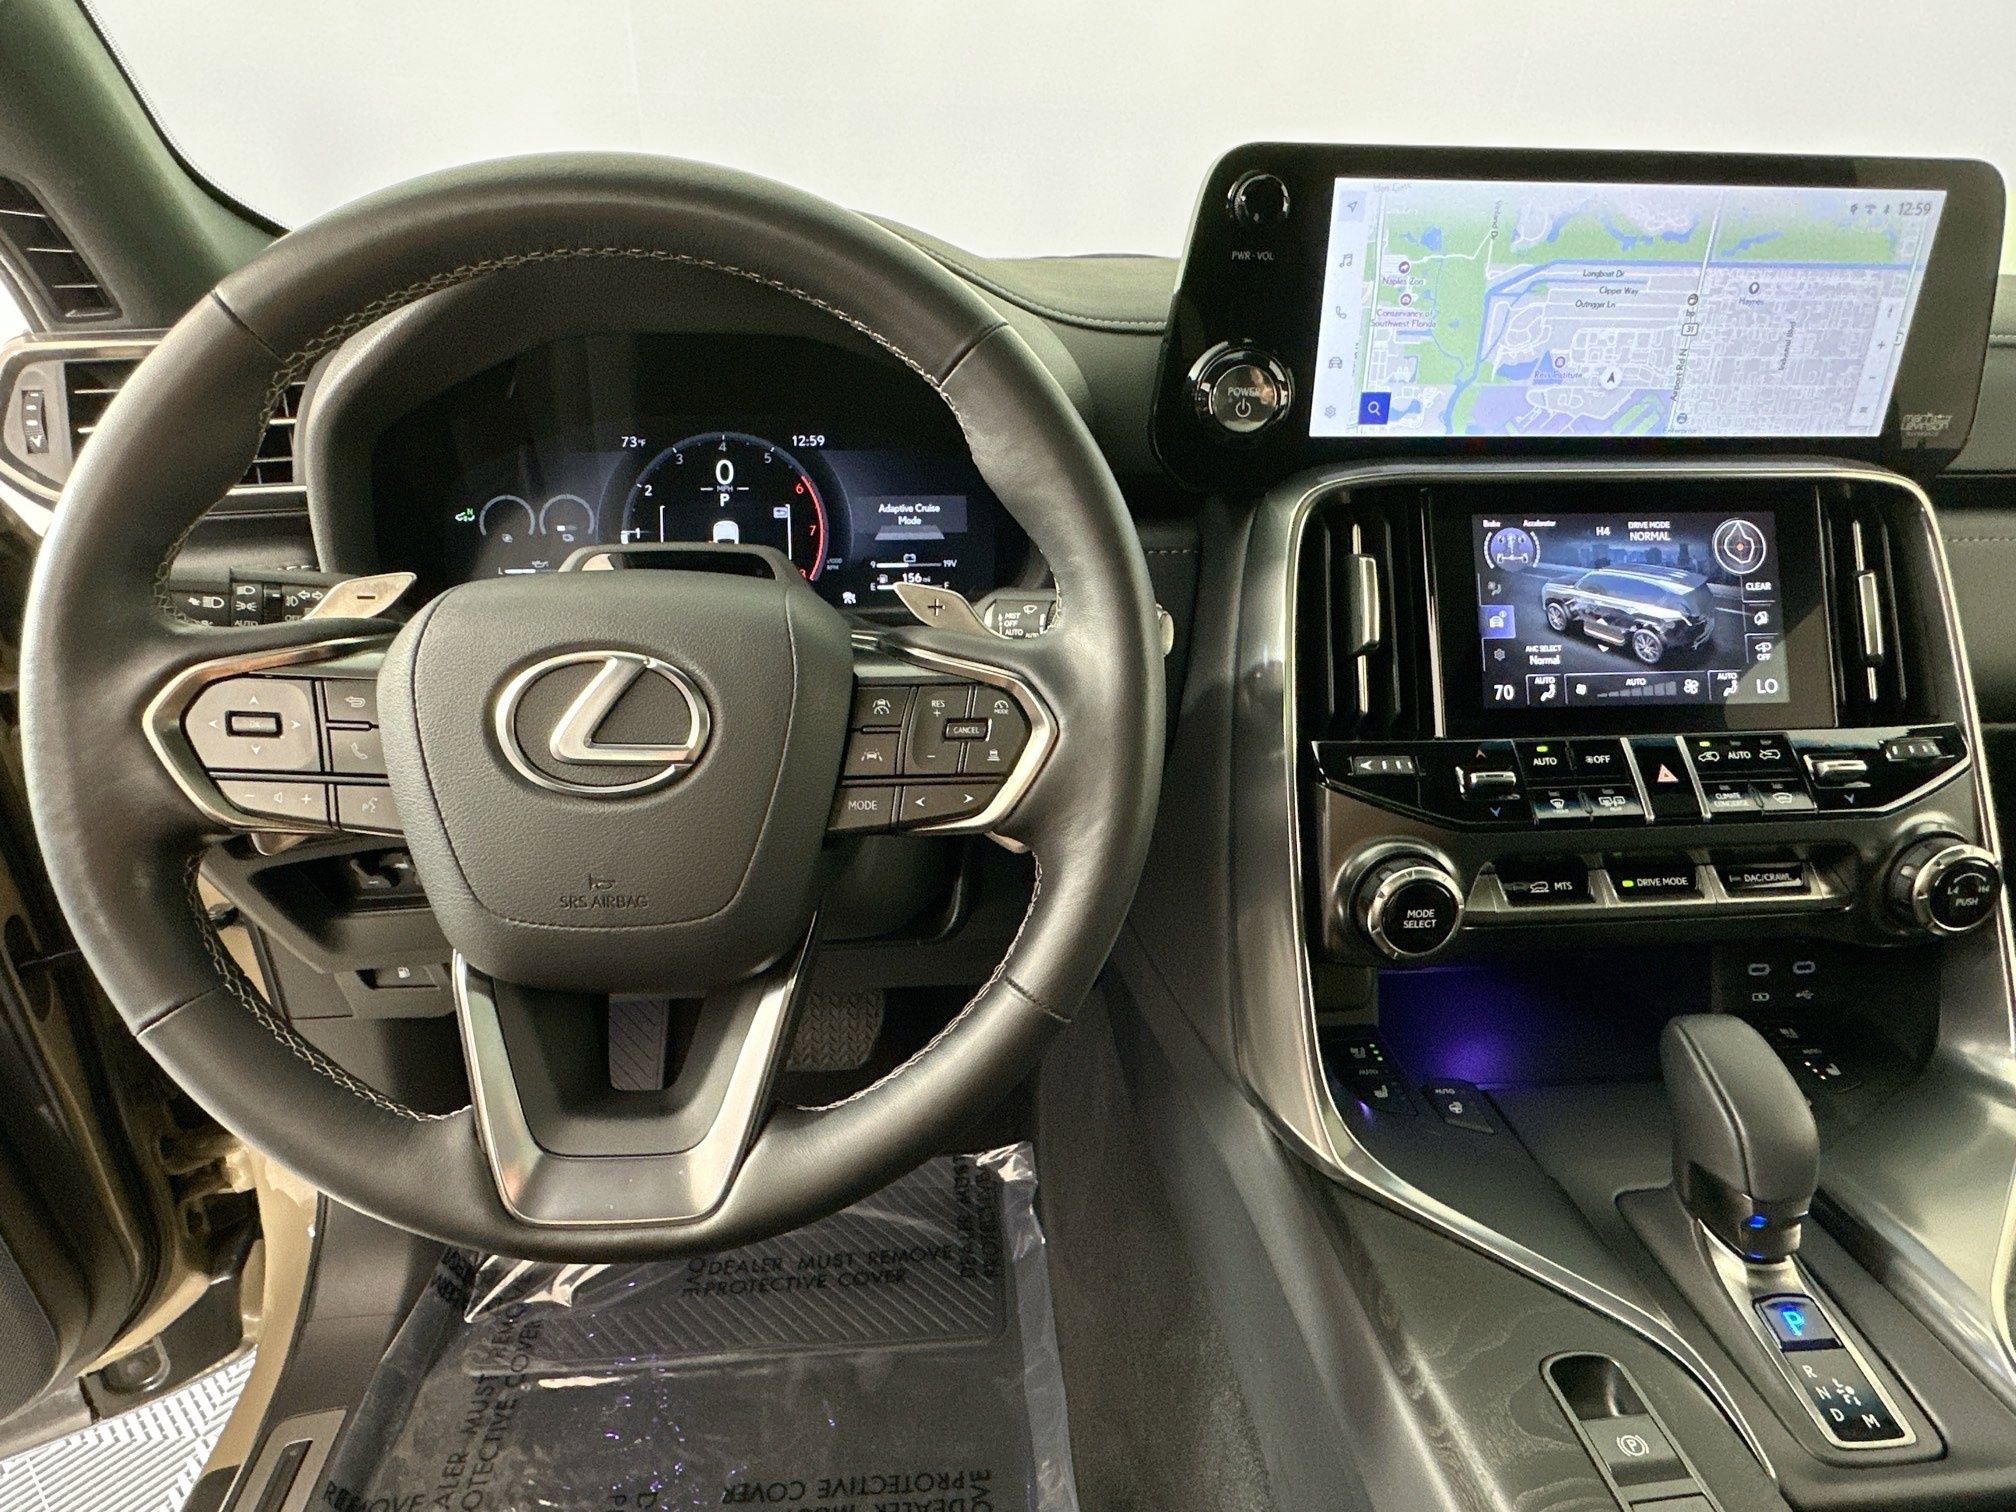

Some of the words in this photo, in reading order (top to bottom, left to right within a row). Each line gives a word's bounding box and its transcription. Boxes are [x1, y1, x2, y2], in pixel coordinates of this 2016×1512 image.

[1898, 202, 1932, 216] 12:59
[1582, 270, 1614, 279] Longboat
[1616, 270, 1625, 278] Dr
[1599, 286, 1622, 296] Clipper
[1624, 287, 1639, 296] Way
[1371, 319, 1409, 327] Southwest
[1227, 387, 1263, 397] POWER
[792, 435, 825, 447] 12:59
[718, 442, 727, 452] 4
[675, 453, 684, 465] 3
[763, 453, 772, 464] 5
[715, 459, 735, 485] 0
[644, 484, 653, 497] 2
[796, 483, 804, 494] 6
[719, 493, 730, 507] P
[878, 503, 914, 515] Adaptive
[914, 503, 941, 513] Cruise
[898, 515, 922, 526] Mode
[1628, 521, 1648, 529] DRIVE
[1649, 521, 1671, 529] MODE
[809, 525, 817, 536] 7
[1596, 527, 1611, 537] H4
[1629, 531, 1671, 542] NORMAL
[902, 573, 922, 583] 156
[1745, 582, 1772, 591] CLEAR
[1003, 620, 1019, 628] OFF
[1004, 628, 1024, 636] AUTO
[1529, 655, 1560, 666] Normal
[1534, 676, 1556, 685] AUTO
[1717, 672, 1738, 681] AUTO
[1625, 678, 1647, 686] AUTO
[1756, 678, 1778, 694] LO
[1493, 684, 1515, 700] 70
[931, 700, 945, 708] RES
[953, 726, 980, 734] CANCEL
[1593, 755, 1611, 764] OFF
[1727, 751, 1751, 760] AUTO
[1533, 757, 1558, 766] AUTO
[848, 800, 877, 811] MODE
[1636, 878, 1662, 887] DRIVE
[1662, 876, 1688, 886] MODE
[1743, 873, 1793, 883] DAC/CRAWL
[1554, 881, 1573, 890] MTS
[1947, 887, 1960, 895] L4
[559, 895, 587, 908] SRS
[591, 895, 649, 908] AIRBAG
[1955, 898, 1979, 907] PUSH
[1406, 909, 1435, 919] MODE
[1403, 919, 1437, 929] SELECT
[798, 1253, 856, 1271] MUST
[1783, 1311, 1805, 1336] P
[1802, 1365, 1817, 1379] R
[1815, 1386, 1831, 1400] N
[1830, 1408, 1845, 1422] D
[1861, 1413, 1881, 1429] M
